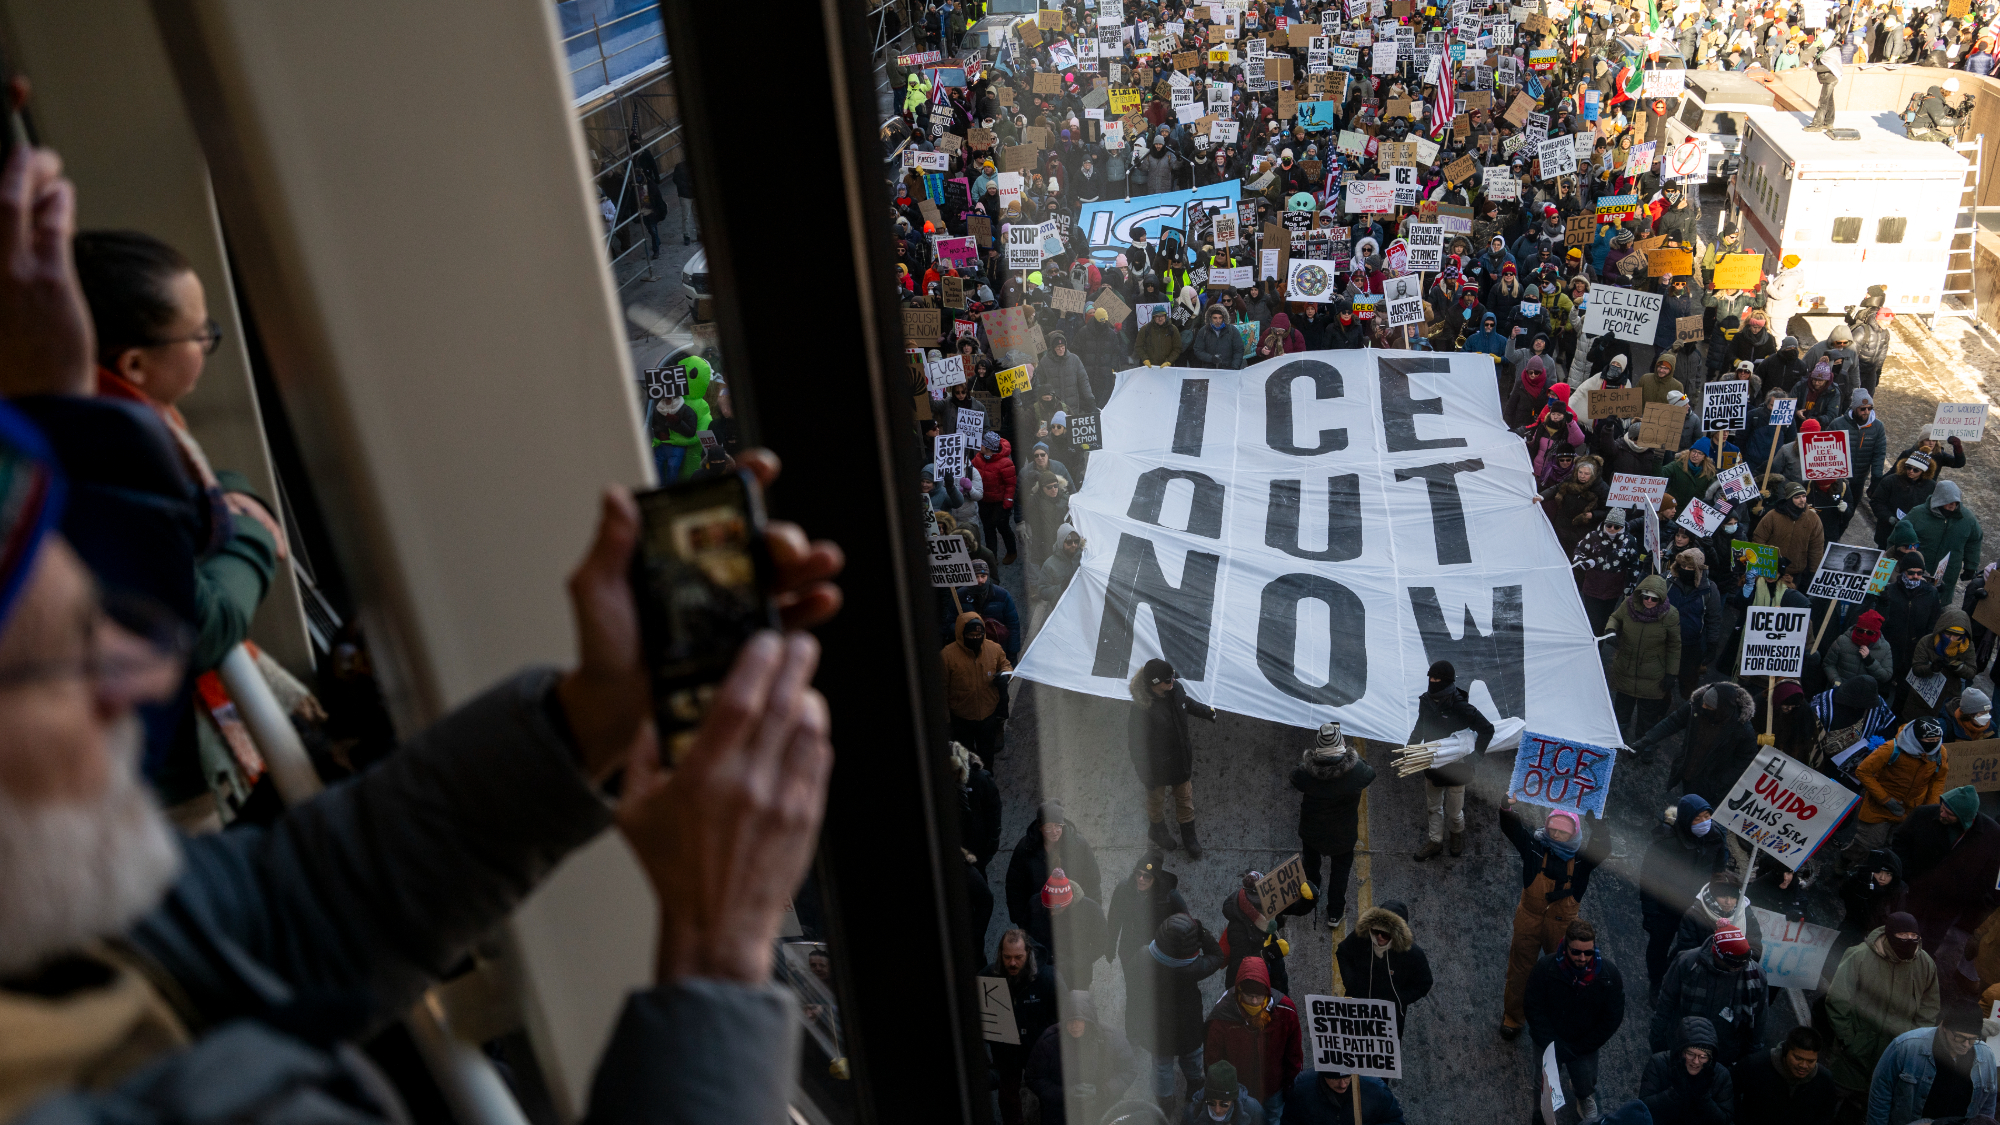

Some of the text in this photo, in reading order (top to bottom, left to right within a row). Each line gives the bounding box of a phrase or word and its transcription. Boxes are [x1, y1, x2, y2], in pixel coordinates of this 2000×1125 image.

[1042, 12, 1060, 20] FUCK
[1323, 12, 1340, 22] STOP
[1314, 38, 1324, 50] ICE
[1346, 48, 1358, 56] OUT
[1038, 75, 1058, 84] ICE
[1036, 84, 1058, 93] OUT
[1210, 104, 1230, 112] JUSTICE
[1529, 121, 1547, 130] ICE
[1506, 135, 1520, 148] LOVE
[1395, 168, 1412, 185] ICE
[1544, 168, 1558, 176] FIGHT
[1614, 204, 1636, 212] OUT
[1050, 212, 1070, 225] END
[1439, 217, 1472, 231] STRONG
[1568, 216, 1595, 232] ICE
[1010, 228, 1038, 244] STOP
[1217, 230, 1236, 240] ICE
[1411, 226, 1442, 236] EXPAND THE
[1410, 234, 1442, 246] GENERAL
[1566, 232, 1594, 246] OUT
[1010, 250, 1038, 258] ICE TERROR
[1410, 248, 1439, 260] STRIKE!
[1590, 288, 1662, 312] ICE LIKES
[1390, 300, 1420, 318] JUSTICE
[1602, 307, 1651, 324] HURTING
[902, 313, 938, 324] ABOLISH
[1390, 312, 1404, 324] ALEX
[1678, 316, 1703, 330] ICE
[917, 324, 939, 337] NOW
[1603, 319, 1642, 336] PEOPLE
[1678, 328, 1704, 340] OUT!
[995, 338, 1024, 350] MELTS
[929, 358, 964, 374] FUCK
[646, 368, 687, 388] ICE
[936, 373, 962, 386] ICE
[998, 375, 1012, 387] SAY
[648, 383, 689, 400] OUT
[1706, 382, 1747, 395] MINNESOTA
[1591, 392, 1630, 403] Eat Shit
[1709, 393, 1742, 406] STANDS
[1172, 356, 1468, 458] ICE
[1592, 405, 1598, 416] &
[1600, 404, 1614, 416] die
[1616, 403, 1638, 415] nazis
[1778, 399, 1790, 410] ICE
[1943, 405, 1984, 414] GO WOLVES!
[958, 409, 984, 417] FREEDOM
[1640, 406, 1684, 430] ICE
[1704, 405, 1745, 419] AGAINST
[960, 416, 982, 426] AND
[1072, 416, 1096, 426] FREE
[1704, 418, 1744, 431] ICE
[1770, 414, 1792, 426] MPLS
[1937, 416, 1980, 426] ABOLISH ICE!
[956, 424, 984, 434] JUSTICE
[1072, 426, 1096, 438] DON
[1932, 428, 1945, 438] FREE
[940, 436, 962, 448] ICE
[1072, 434, 1098, 446] LEMON
[1642, 427, 1682, 447] OUT
[939, 448, 960, 458] OUT
[1813, 454, 1838, 462] OUT OF
[946, 457, 961, 468] OF
[1808, 460, 1844, 468] MINNESOTA
[1614, 474, 1624, 484] NO
[1624, 476, 1638, 484] ONE
[1718, 464, 1749, 484] RESIST
[1631, 486, 1658, 495] STOLEN
[1608, 492, 1646, 504] INDIGENOUS
[1127, 458, 1485, 566] OUT
[1693, 500, 1724, 521] SILENCE
[938, 539, 962, 554] OUT
[1758, 546, 1774, 557] ICE
[1757, 557, 1777, 568] OUT
[1752, 566, 1778, 580] MEOW
[945, 574, 974, 586] GOOD!
[1815, 571, 1870, 592] JUSTICE
[1810, 584, 1864, 603] RENEE GOOD
[1091, 532, 1525, 722] NOW
[1750, 612, 1806, 633] ICE OUT
[1766, 632, 1787, 640] OF
[1746, 644, 1801, 660] MINNESOTA
[1744, 658, 1798, 673] FOR GOOD!
[1528, 738, 1604, 783] ICE
[1524, 769, 1596, 809] OUT
[1763, 756, 1848, 812] EL PUEBLO
[1755, 774, 1818, 821] UNIDO
[1728, 789, 1809, 847] JAMAS SERA
[1260, 858, 1300, 898] ICE OUT
[1267, 894, 1278, 915] of
[1762, 940, 1815, 977] ICE
[1312, 1000, 1392, 1022] GENERAL
[1314, 1016, 1394, 1038] STRIKE:
[1318, 1035, 1394, 1055] THE PATH TO
[1318, 1051, 1396, 1072] JUSTICE
